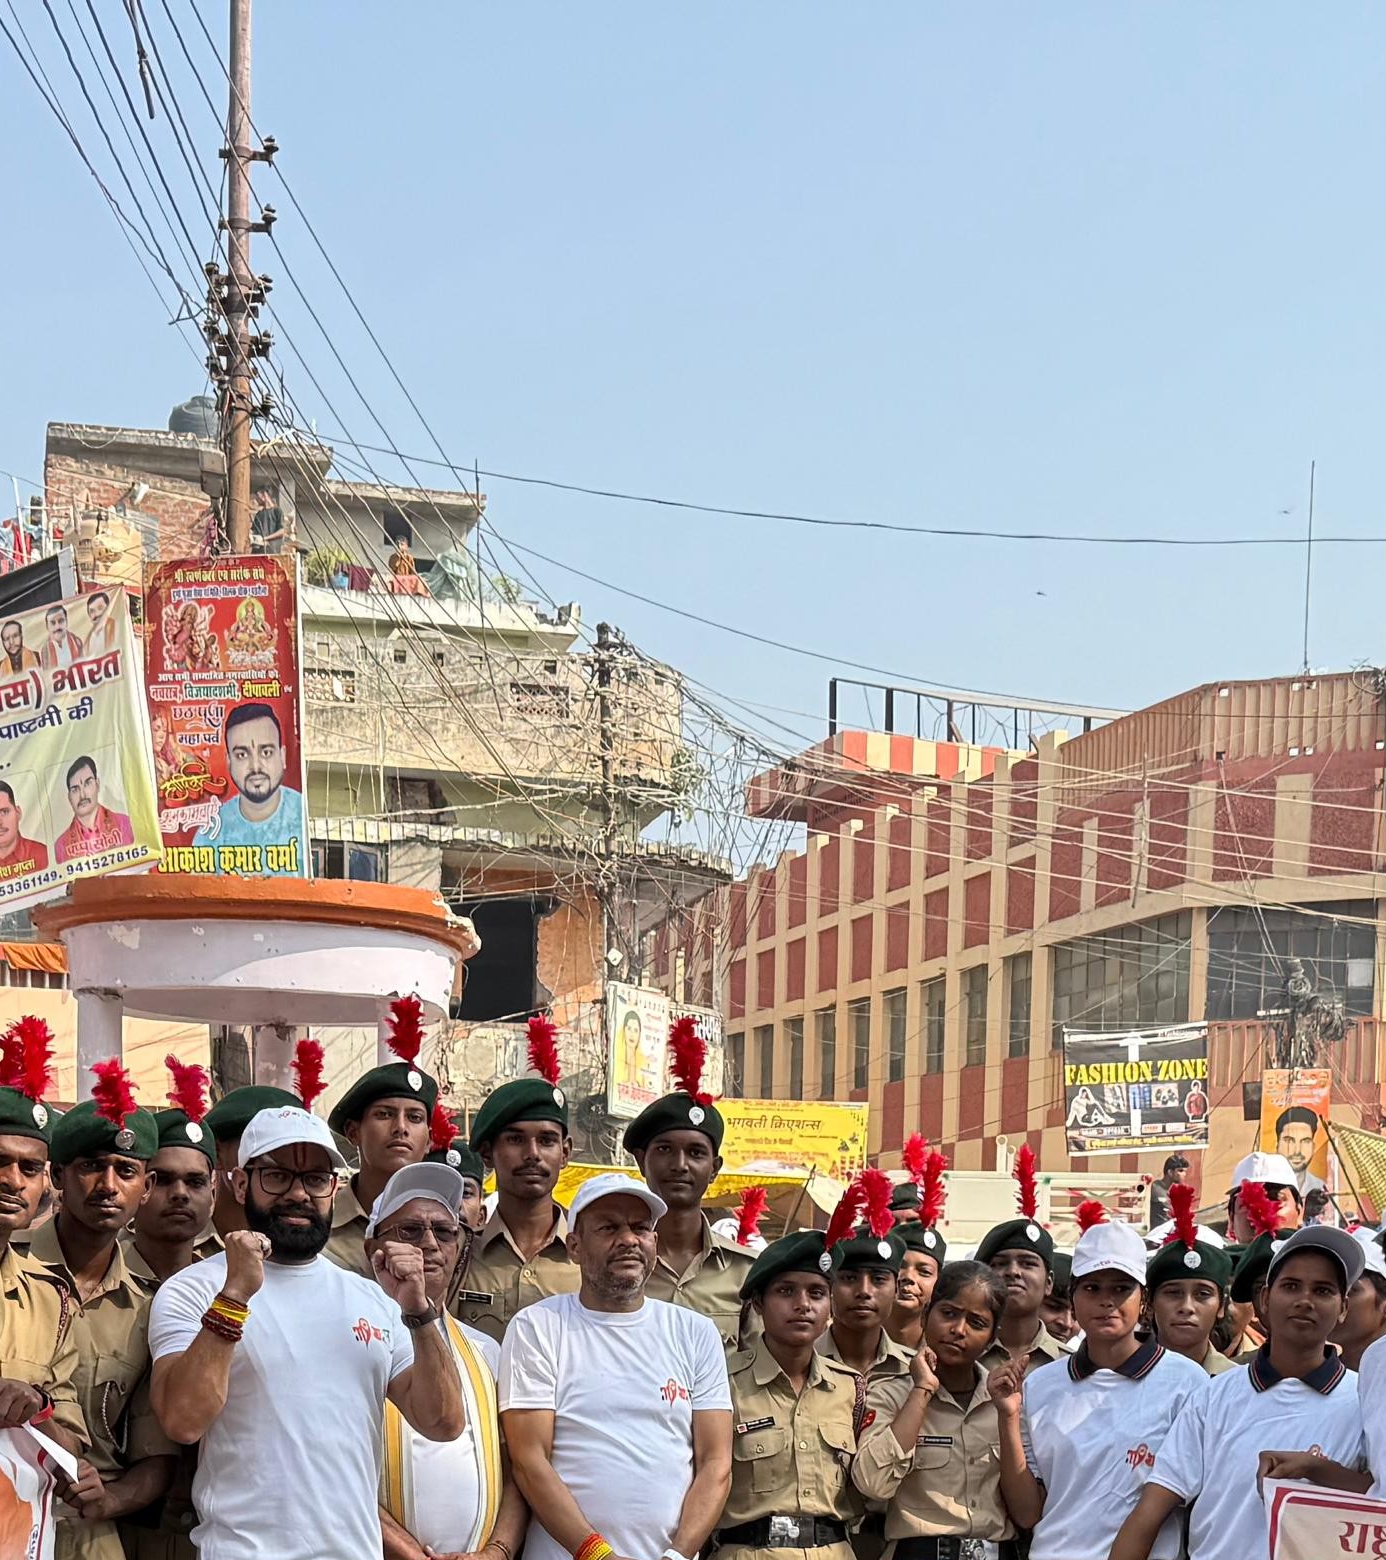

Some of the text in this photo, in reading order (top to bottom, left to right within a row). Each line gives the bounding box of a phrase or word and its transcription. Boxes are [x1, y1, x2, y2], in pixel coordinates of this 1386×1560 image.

[51, 648, 123, 694] भारत
[66, 695, 95, 722] की
[66, 845, 149, 875] 9415278165
[157, 835, 300, 876] आकाश कुमार वर्मा
[1064, 1057, 1209, 1087] FASHION ZONE
[727, 1114, 822, 1132] भगवती क्रिएशन्स
